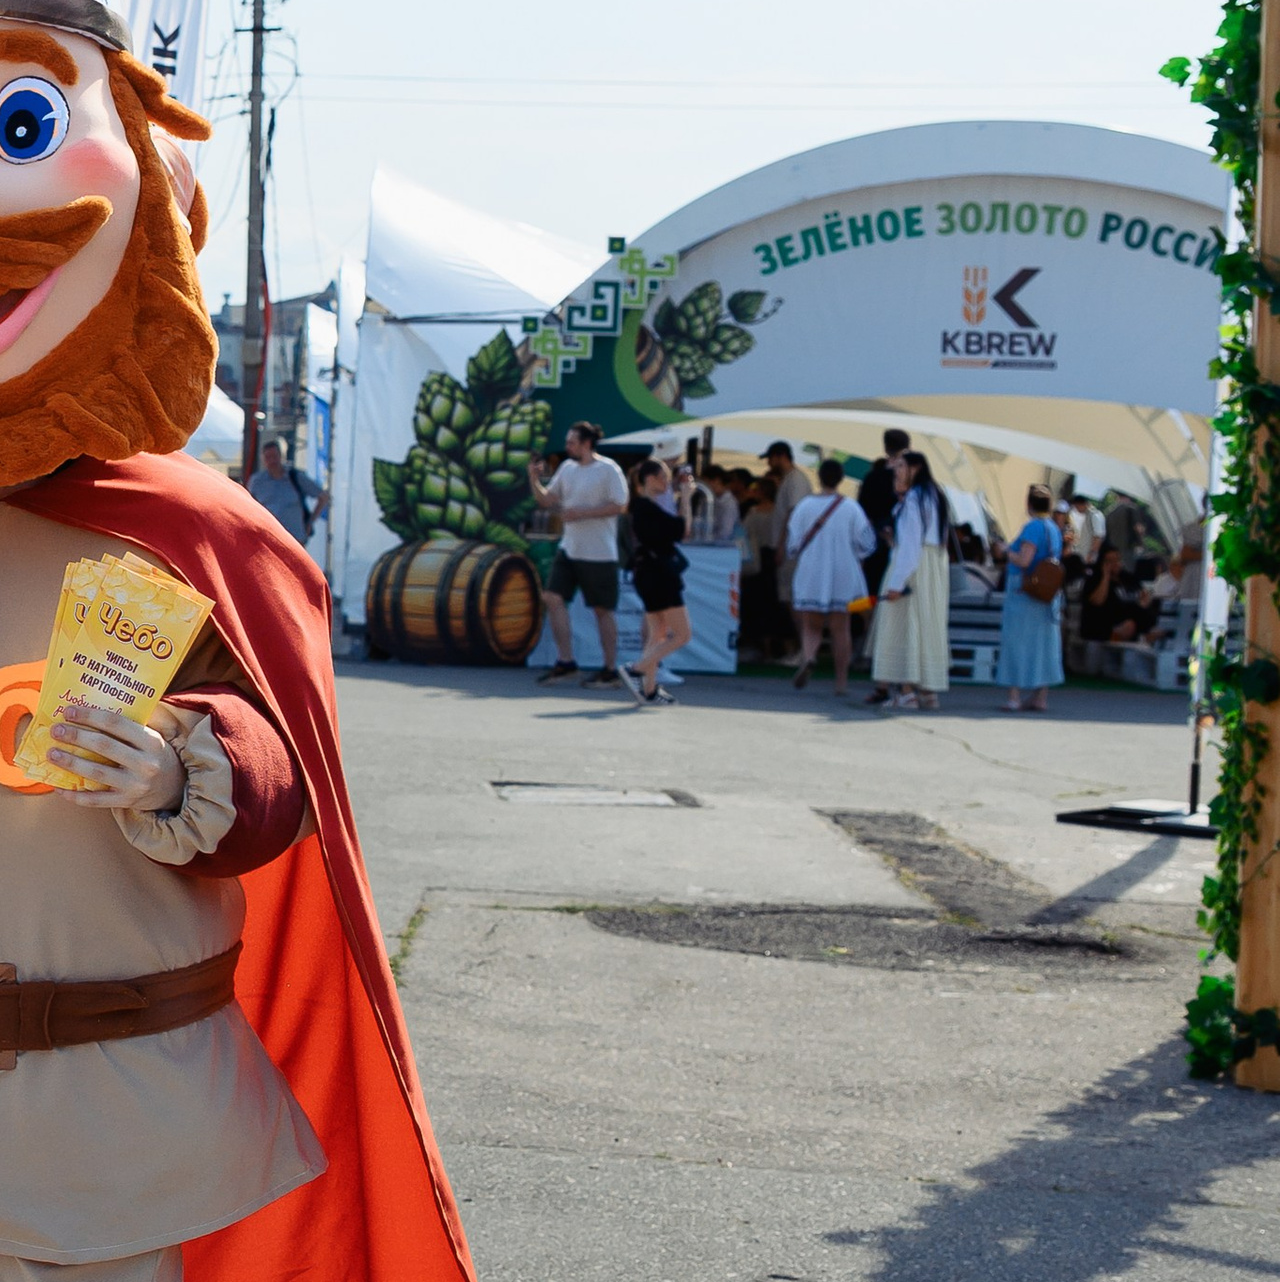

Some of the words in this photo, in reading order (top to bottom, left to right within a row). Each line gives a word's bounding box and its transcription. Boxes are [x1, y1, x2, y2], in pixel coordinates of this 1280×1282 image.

[754, 206, 925, 276] ЗЕЛЁНОЕ
[936, 201, 1089, 239] ЗОЛОТО
[1099, 211, 1221, 272] РОССИ
[941, 329, 1058, 357] KBREW
[99, 602, 173, 660] Чебо
[72, 652, 86, 666] ИЗ
[86, 659, 156, 699] НАТУРАЛЬНОГО
[105, 650, 139, 673] ЧИПСЫ
[58, 689, 114, 711] Люби
[79, 672, 136, 706] КАРТОФЕЛЯ
